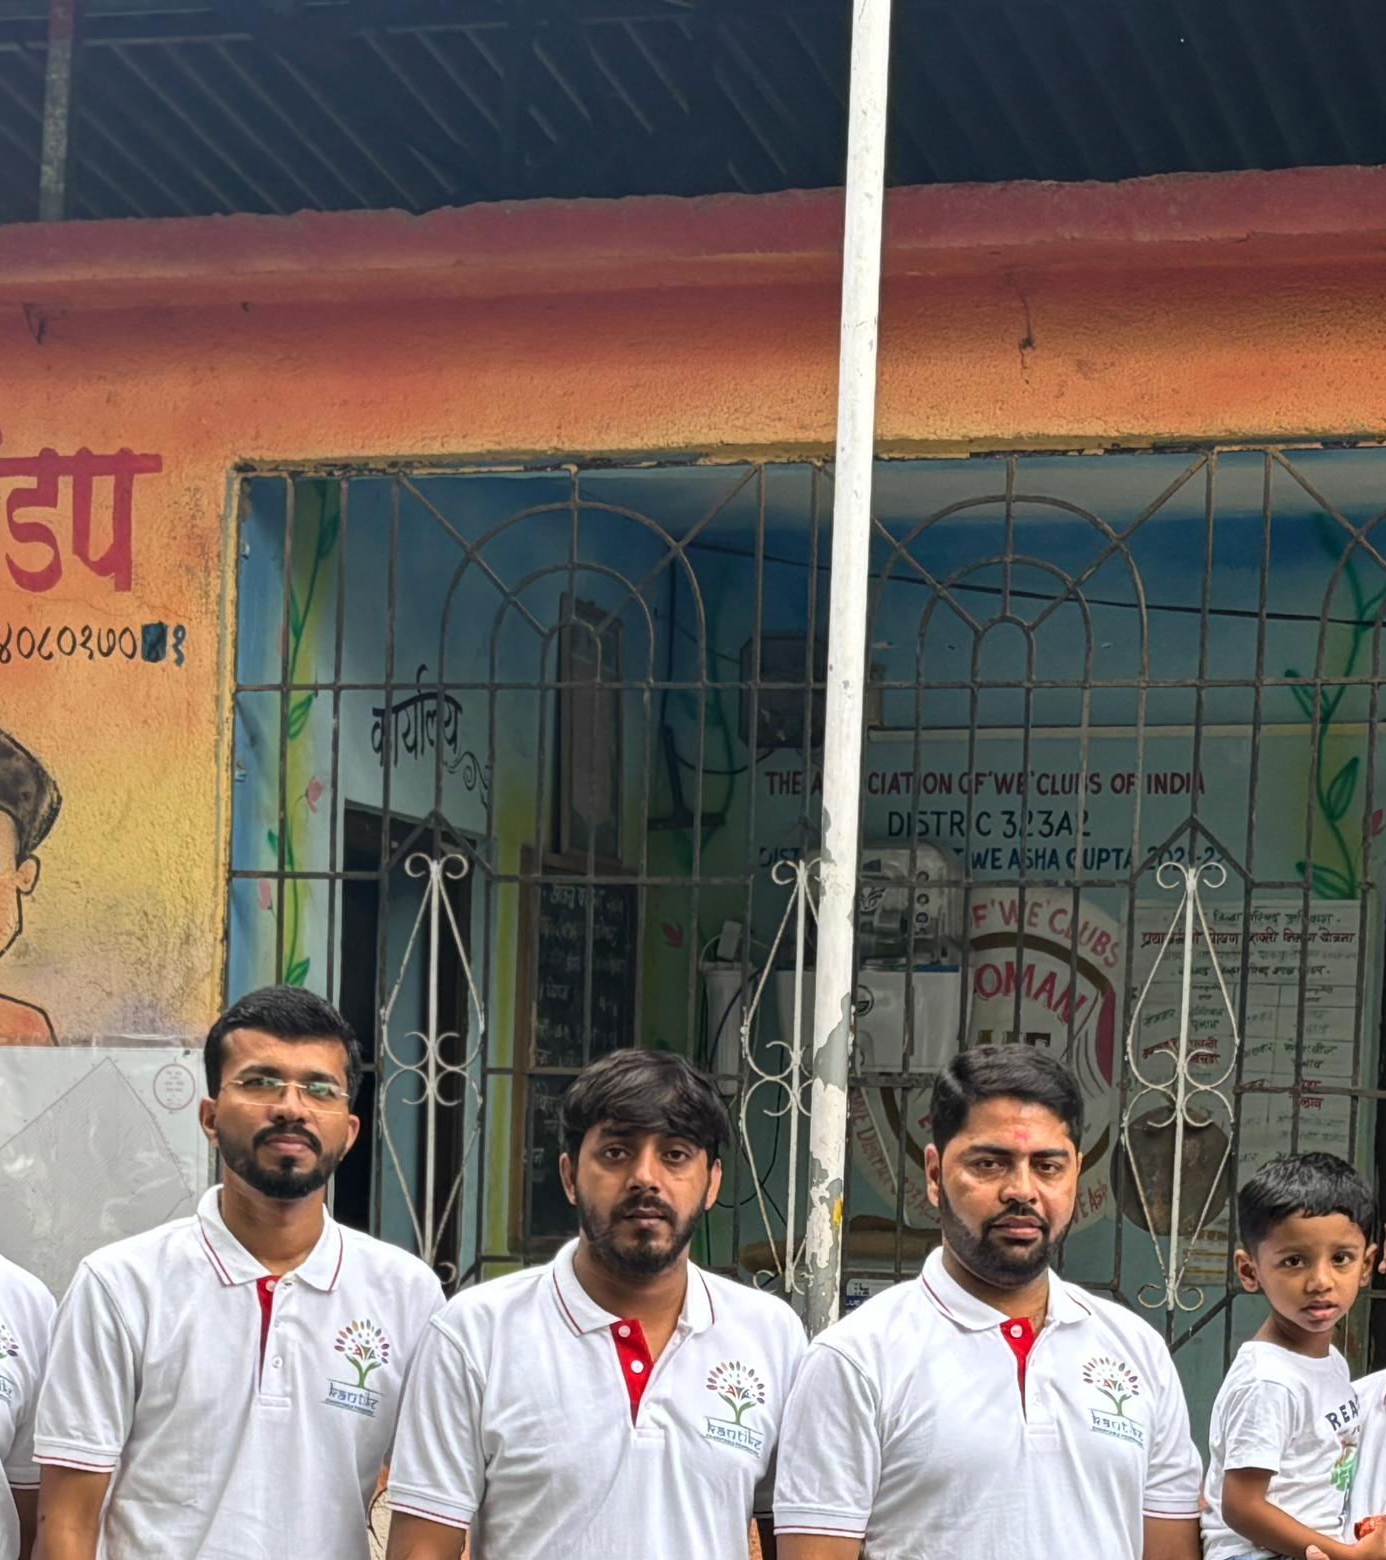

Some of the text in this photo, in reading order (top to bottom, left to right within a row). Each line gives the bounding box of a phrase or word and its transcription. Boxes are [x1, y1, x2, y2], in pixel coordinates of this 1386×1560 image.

[371, 663, 463, 769] कार्यालय
[765, 771, 803, 795] THE
[887, 810, 992, 839] DISTRC
[971, 848, 1003, 870] WE
[1006, 848, 1060, 870] ASHA
[1066, 848, 1133, 870] GUPTA
[974, 960, 1088, 1025] OMAN
